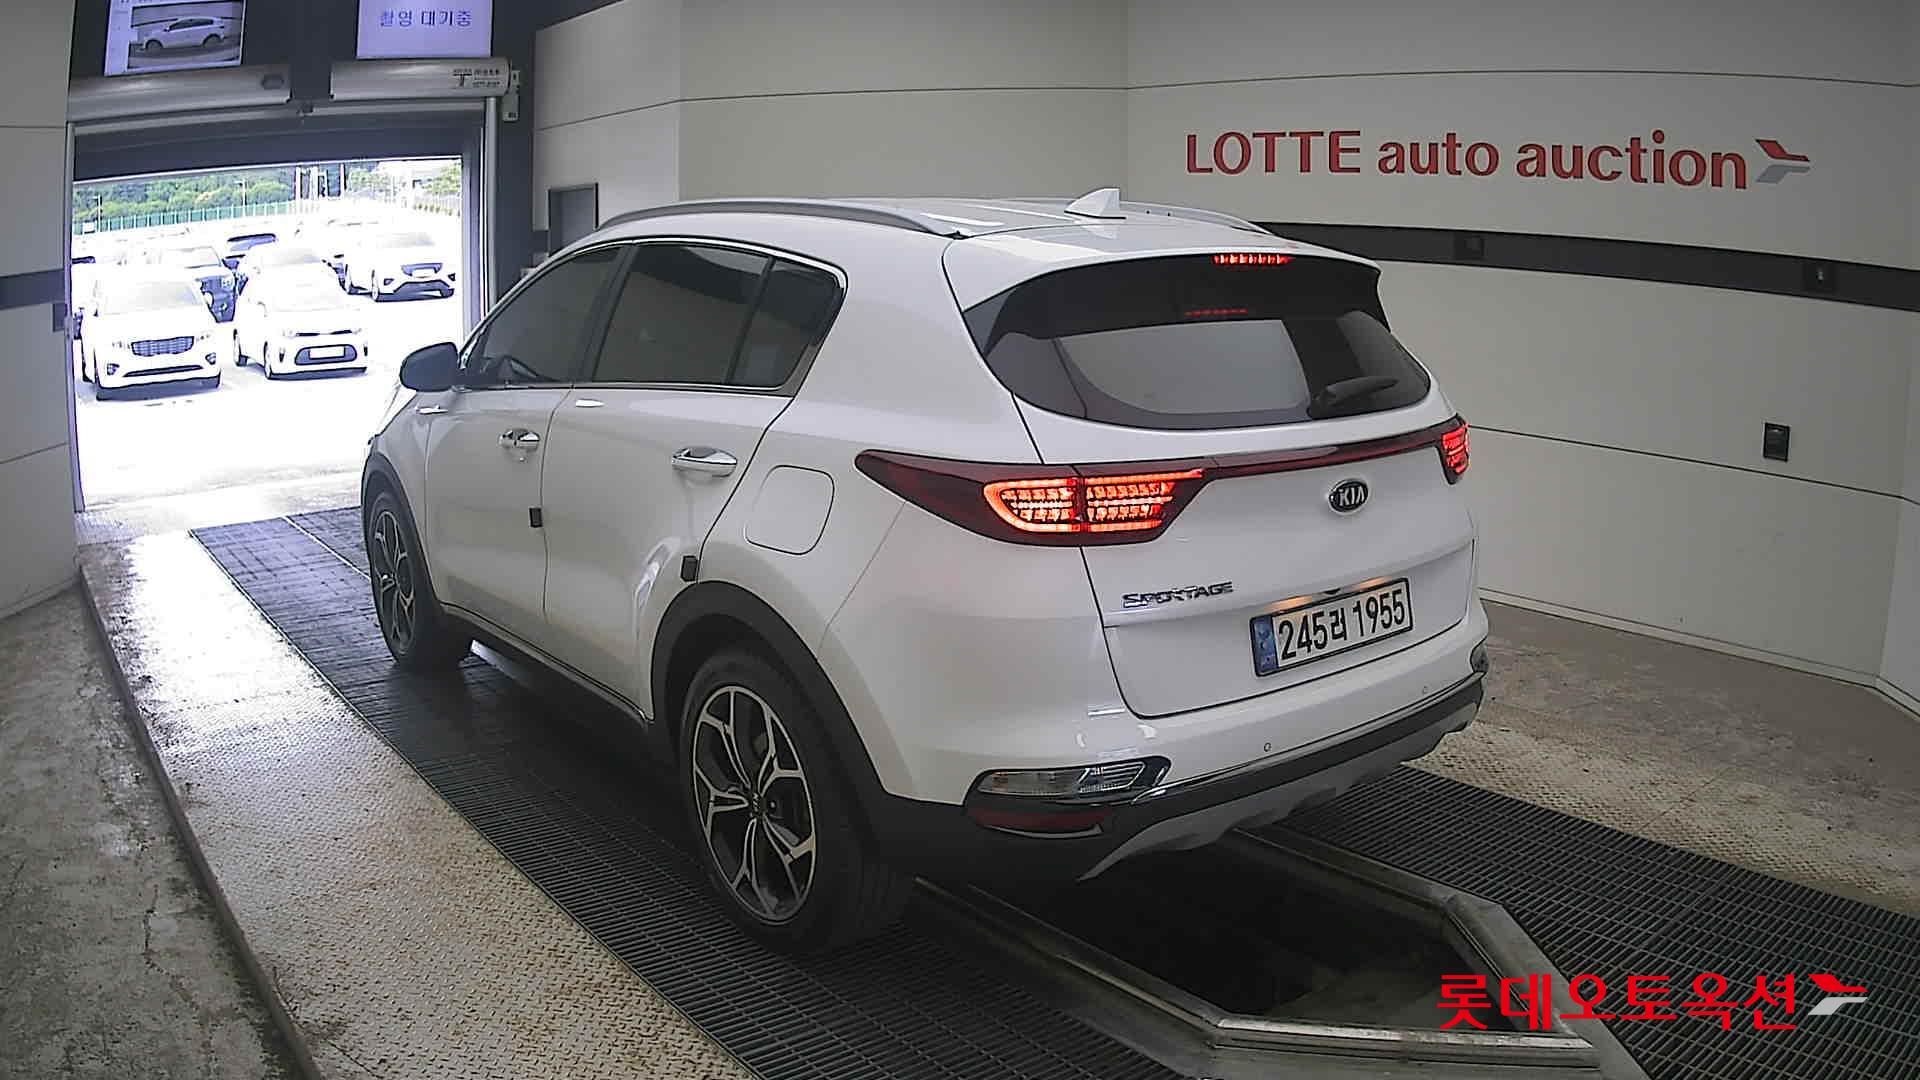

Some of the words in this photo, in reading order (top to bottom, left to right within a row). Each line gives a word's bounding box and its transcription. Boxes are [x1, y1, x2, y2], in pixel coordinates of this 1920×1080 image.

[421, 10, 471, 27] 대기중
[1186, 130, 1361, 175] LOTTE
[1377, 131, 1500, 177] auto
[1515, 130, 1747, 190] auction
[1338, 485, 1365, 506] KIA
[1121, 580, 1233, 608] SPORTAGE
[1352, 588, 1405, 637] 1955
